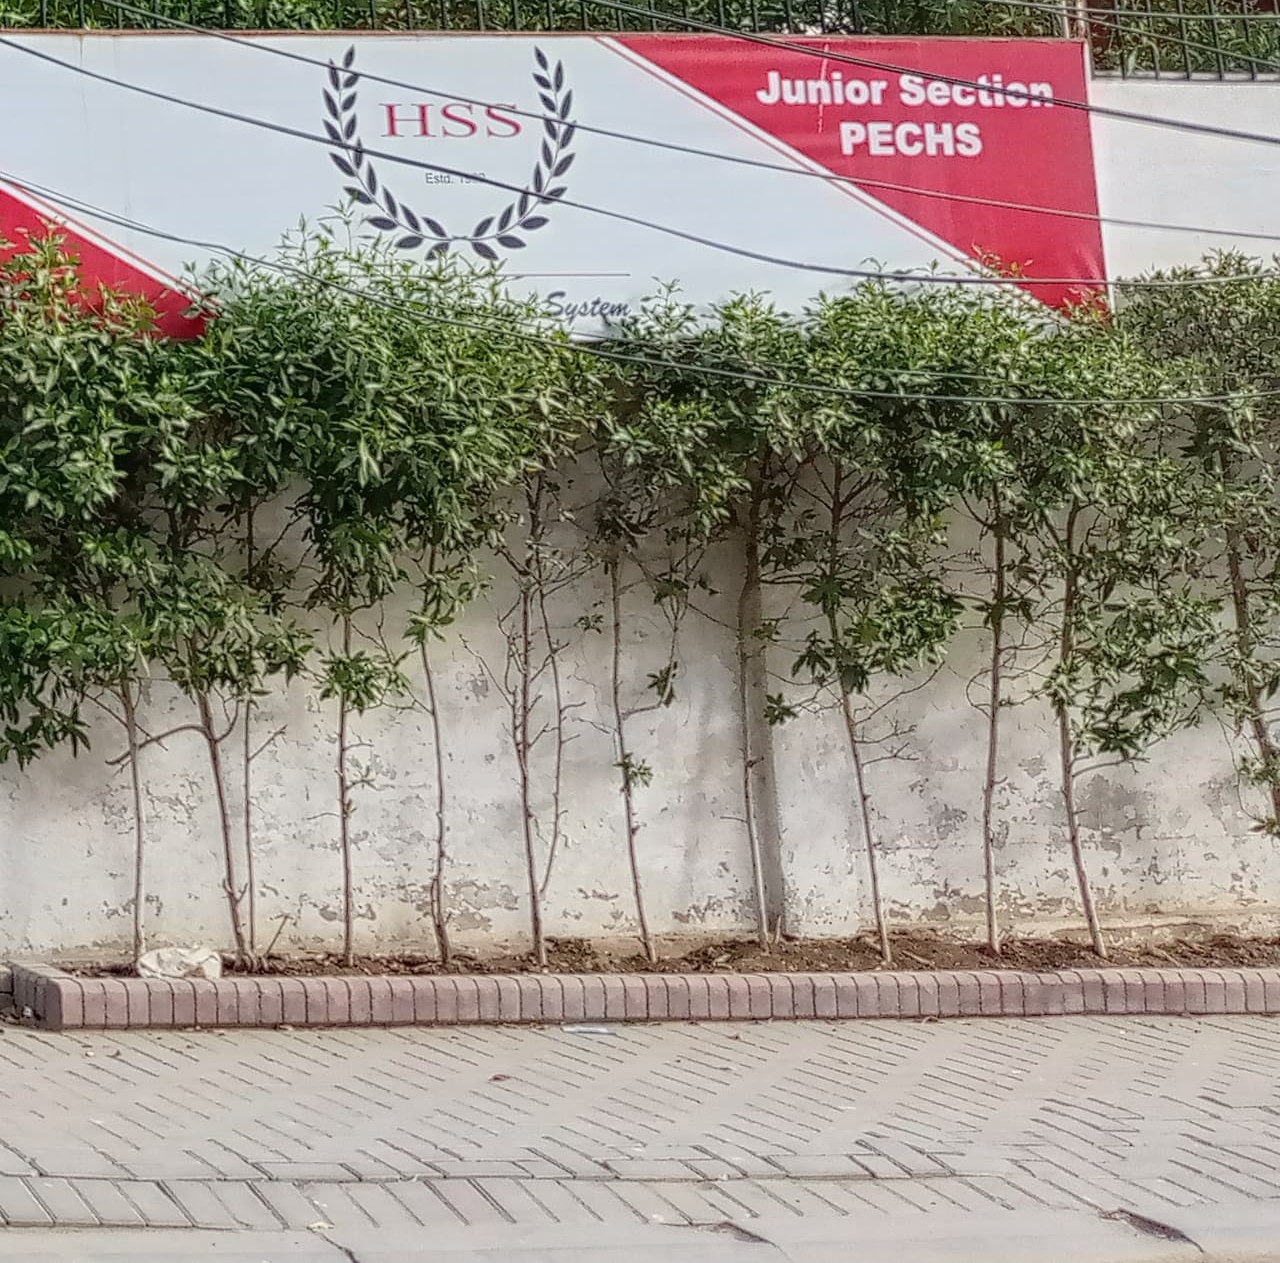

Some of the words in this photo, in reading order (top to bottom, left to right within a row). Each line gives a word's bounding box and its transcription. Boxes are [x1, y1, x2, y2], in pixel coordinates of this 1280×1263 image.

[756, 71, 886, 105] Junior
[899, 74, 1054, 108] Section
[378, 102, 522, 138] HSS
[841, 122, 982, 157] PECHS
[545, 291, 631, 325] System
